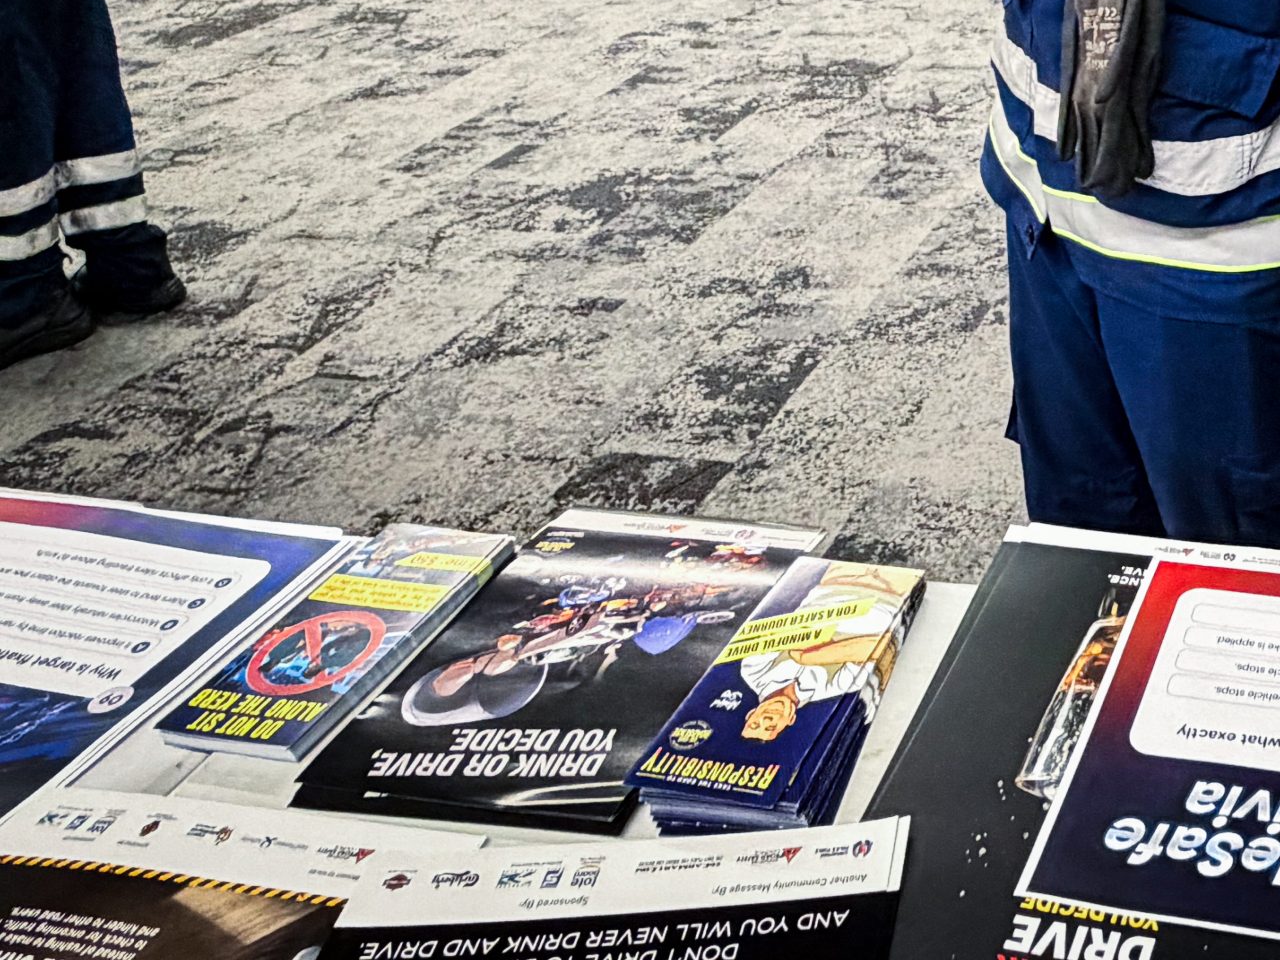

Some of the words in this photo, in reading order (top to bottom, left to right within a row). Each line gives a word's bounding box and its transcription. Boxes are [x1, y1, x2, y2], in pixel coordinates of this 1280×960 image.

[789, 610, 824, 626] SAFER
[826, 608, 834, 620] A
[836, 604, 858, 617] FOR
[738, 616, 788, 638] JOURNEY
[814, 628, 822, 640] A
[762, 630, 812, 648] MINDFUL
[724, 640, 760, 659] DRIVE
[30, 655, 77, 672] target
[76, 664, 89, 676] is
[92, 663, 122, 682] Why
[187, 688, 238, 712] KERB
[1215, 687, 1245, 697] stops.
[234, 693, 271, 716] THE
[186, 710, 223, 732] SIT
[218, 714, 259, 737] NOT
[258, 719, 284, 740] DO
[451, 728, 560, 752] DECIDE.
[560, 728, 617, 752] YOU
[1177, 724, 1236, 741] exactly
[366, 748, 463, 777] DRIVE,
[468, 752, 510, 776] OR
[508, 752, 605, 777] DRINK
[640, 746, 780, 789] RESPONSIBILITY
[432, 871, 479, 890] Carlsberg
[774, 878, 827, 890] Community
[830, 873, 867, 885] Another
[728, 882, 771, 894] Message
[536, 896, 589, 908] Sponsored
[37, 910, 66, 922] road
[63, 914, 94, 926] other
[91, 917, 105, 928] to
[797, 910, 850, 930] AND
[35, 922, 86, 939] oncoming
[102, 920, 140, 935] kinder
[136, 925, 160, 938] and
[676, 920, 732, 940] WILL
[740, 916, 788, 936] YOU
[4, 932, 35, 945] make
[32, 938, 46, 948] to
[44, 936, 85, 952] rushing
[84, 931, 103, 943] for
[102, 934, 134, 949] check
[502, 932, 580, 953] DRINK
[586, 925, 668, 947] NEVER
[1003, 914, 1156, 960] DRIVE
[134, 940, 148, 951] to
[360, 940, 438, 960] DRIVE.
[443, 937, 500, 956] AND
[668, 943, 739, 960] DON'T
